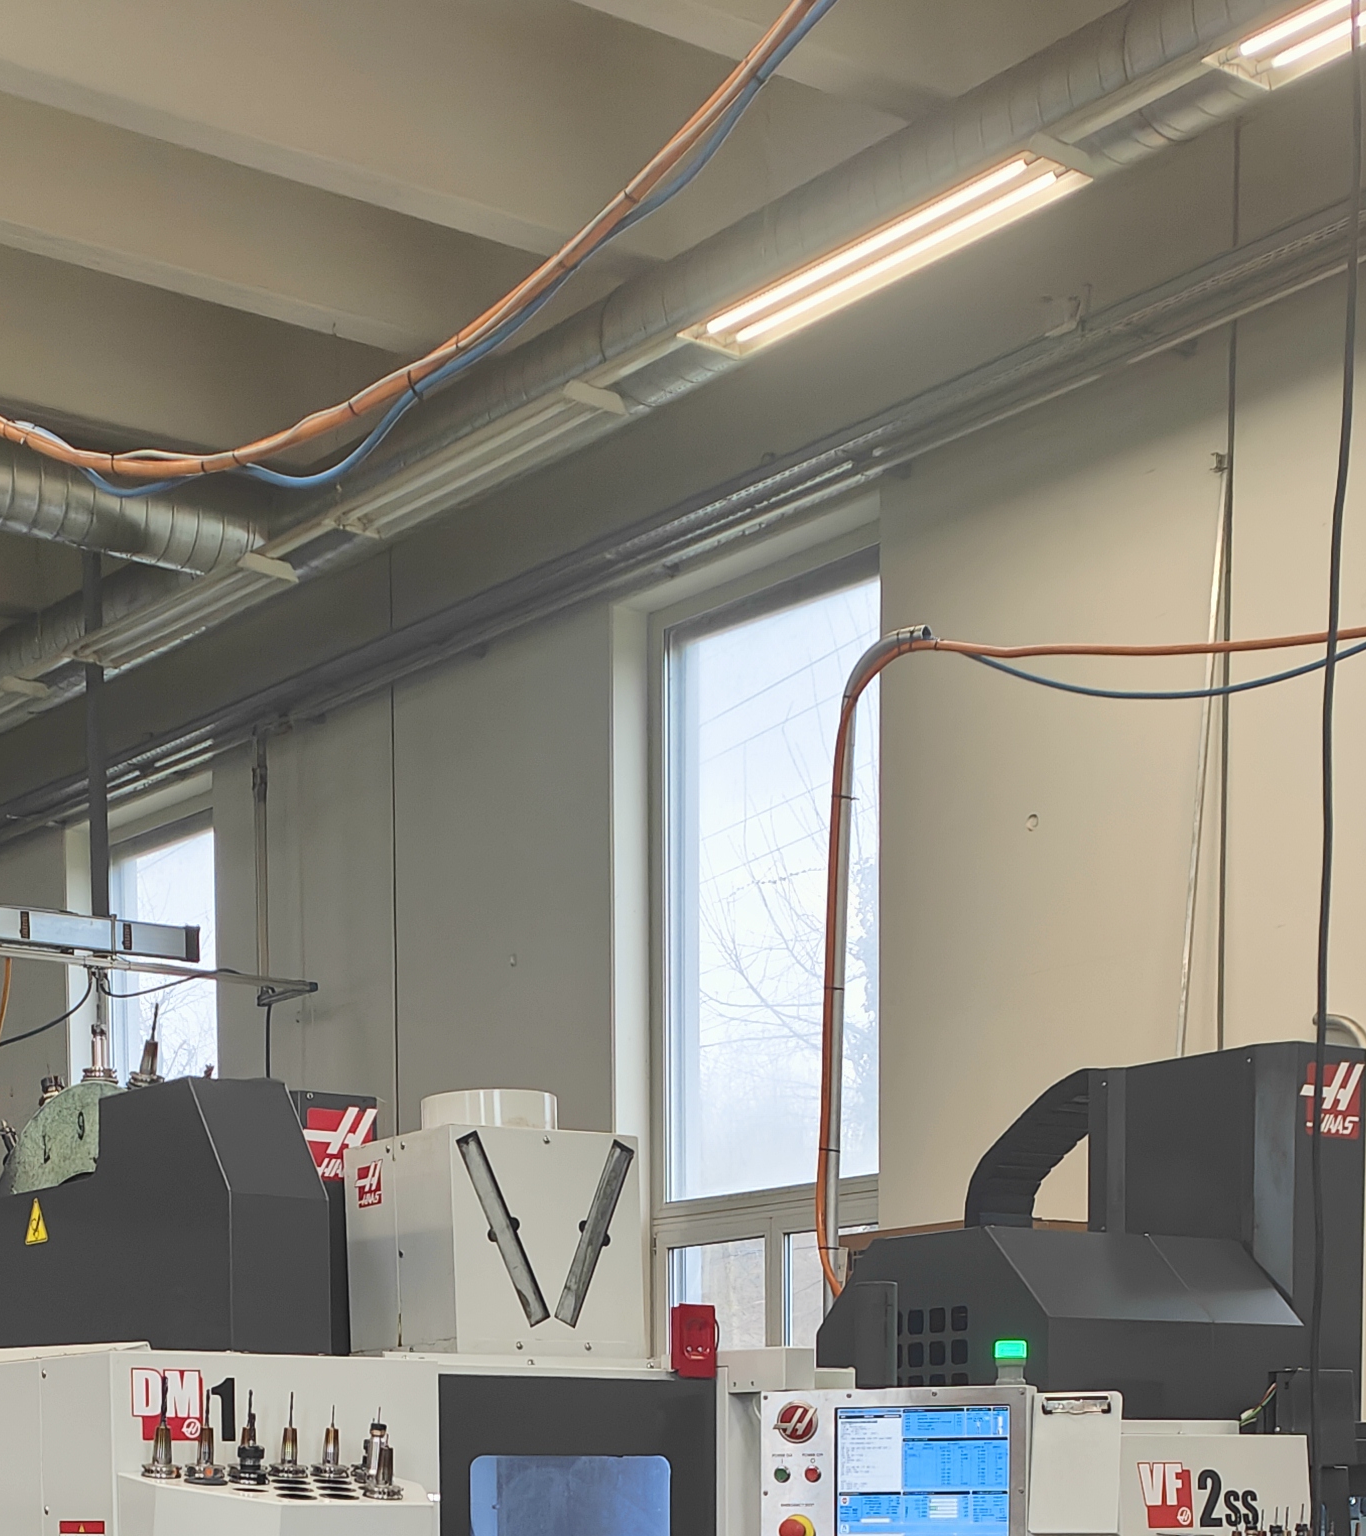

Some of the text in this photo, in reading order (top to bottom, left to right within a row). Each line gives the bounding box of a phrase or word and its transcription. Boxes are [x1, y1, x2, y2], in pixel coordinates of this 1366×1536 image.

[131, 1367, 237, 1442] DM 1
[1137, 1462, 1183, 1507] VF
